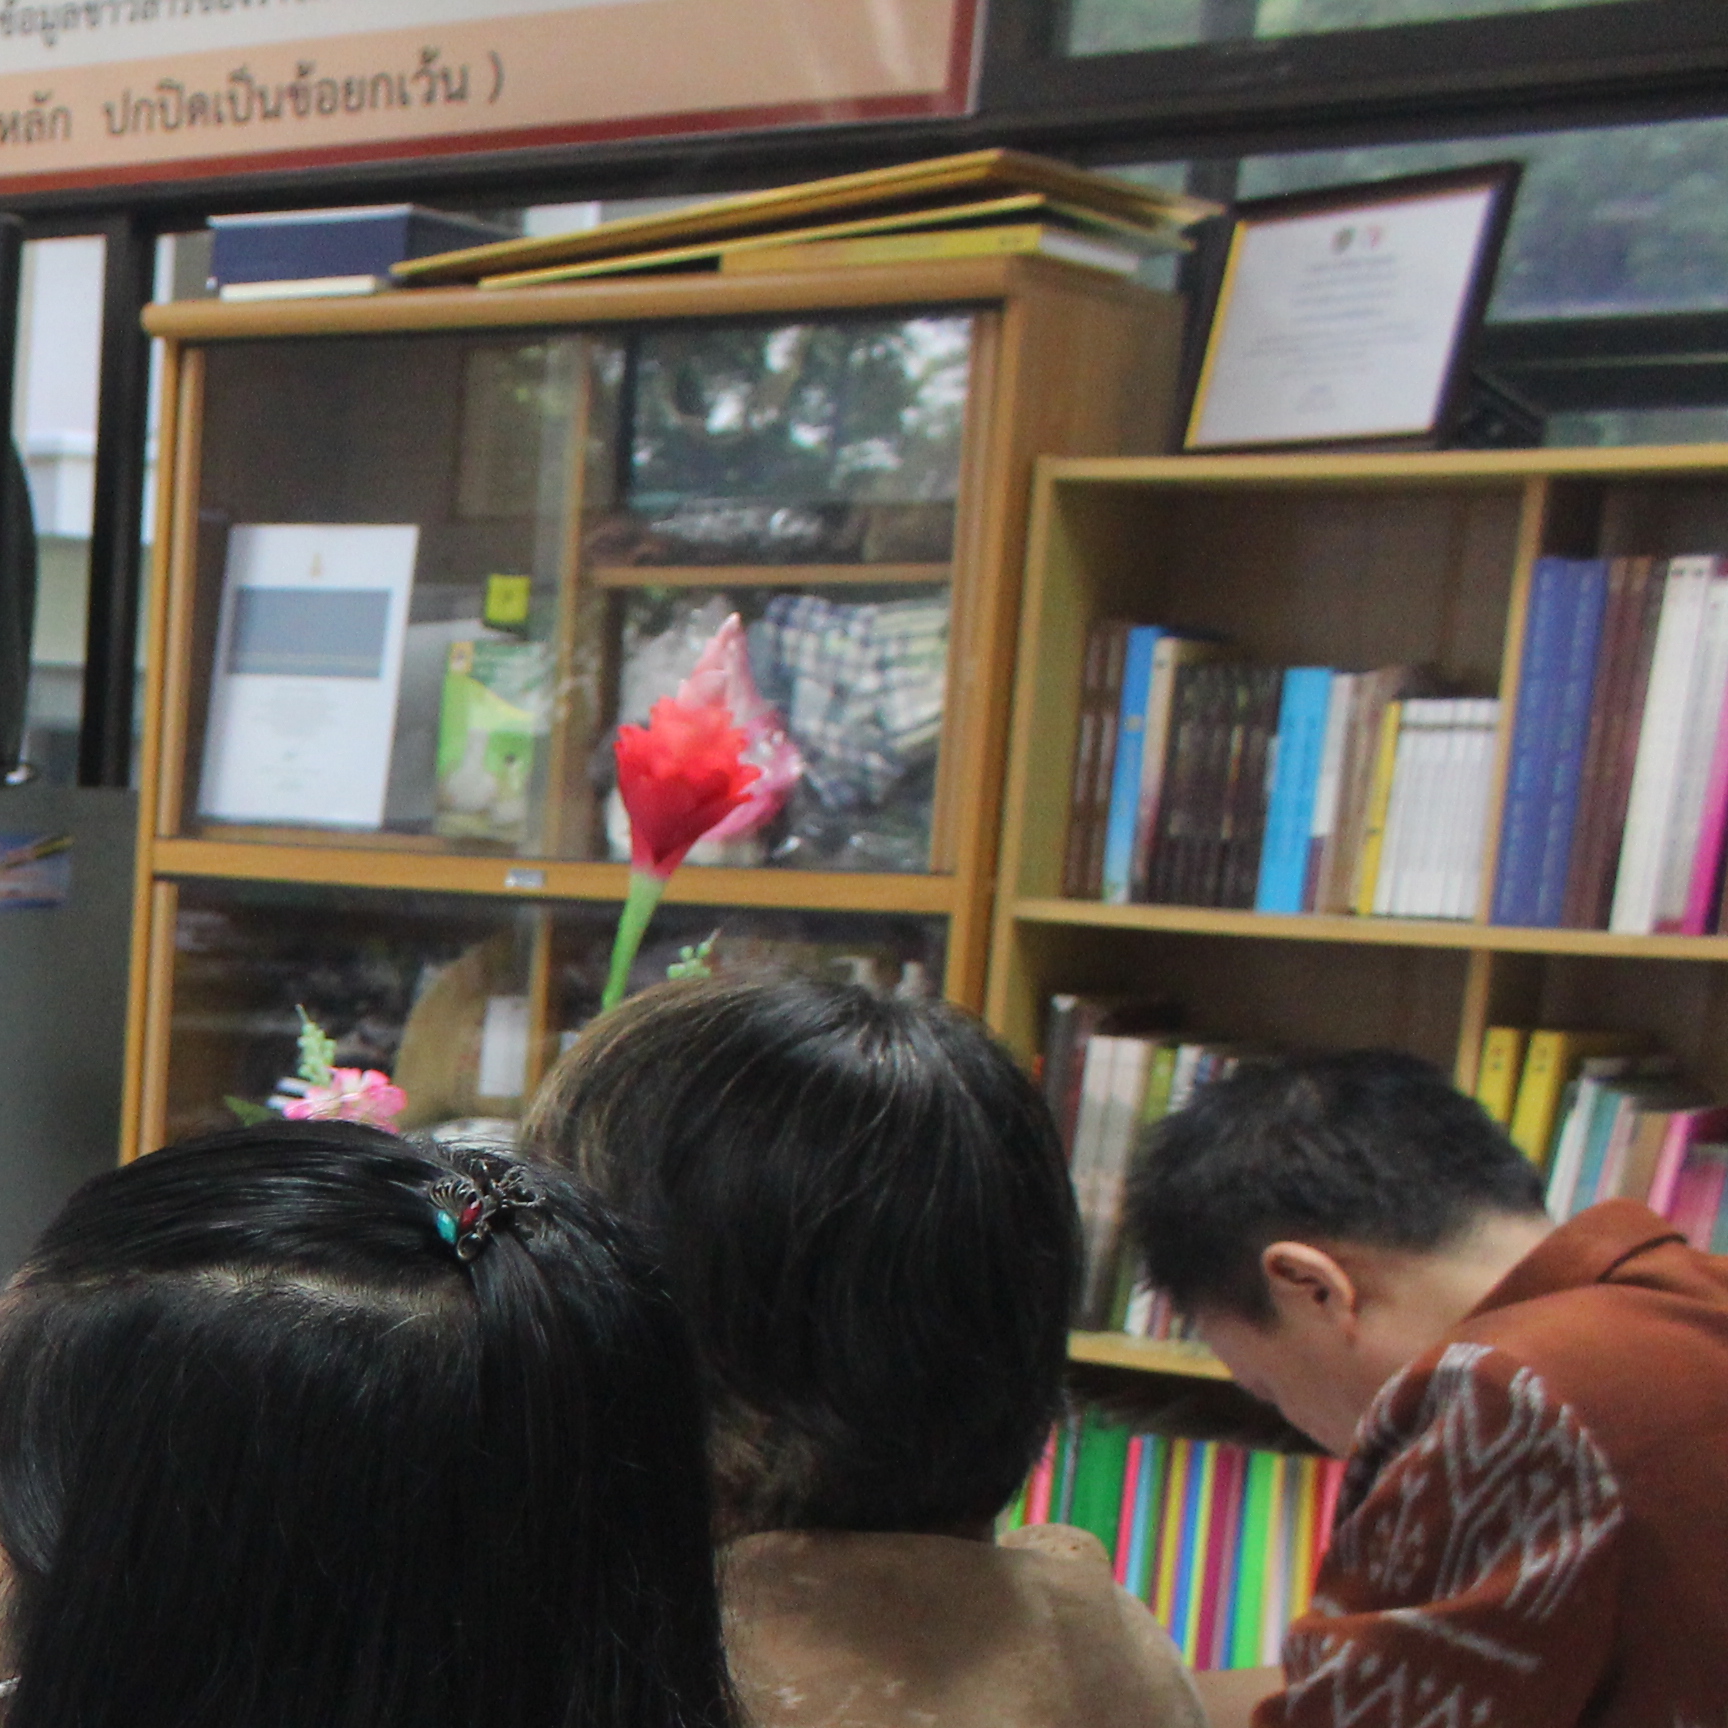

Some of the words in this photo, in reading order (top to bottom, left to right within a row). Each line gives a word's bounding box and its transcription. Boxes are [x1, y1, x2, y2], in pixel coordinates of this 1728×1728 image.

[102, 45, 470, 136] ปกปิดเป็นข้อยกเว้น
